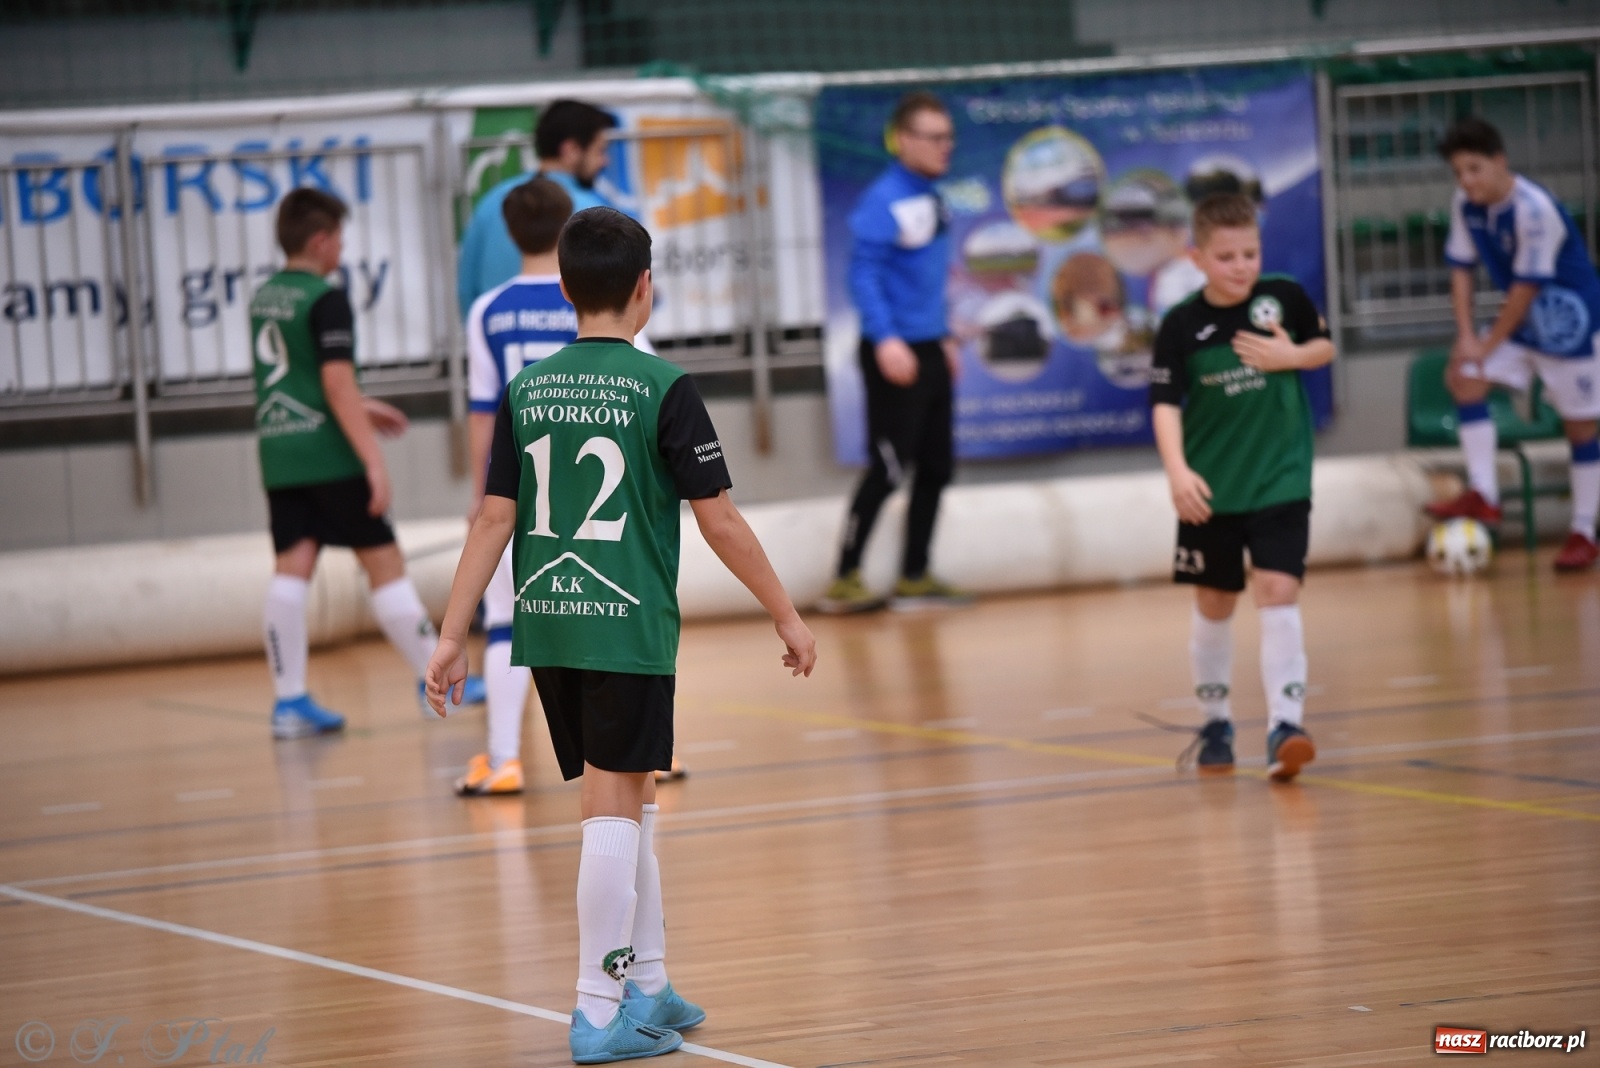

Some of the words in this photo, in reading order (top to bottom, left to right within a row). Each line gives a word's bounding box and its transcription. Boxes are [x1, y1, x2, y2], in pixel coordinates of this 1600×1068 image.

[0, 136, 374, 227] BORSKI
[256, 320, 290, 389] 9
[527, 388, 589, 402] MŁODEGO
[591, 389, 628, 403] LKS-u
[577, 374, 650, 398] PIŁKARSKA
[520, 402, 635, 428] TWORKÓW
[694, 440, 720, 455] HYDRO
[697, 451, 722, 464] Marcin
[524, 433, 628, 542] 12
[551, 575, 585, 594] K.K
